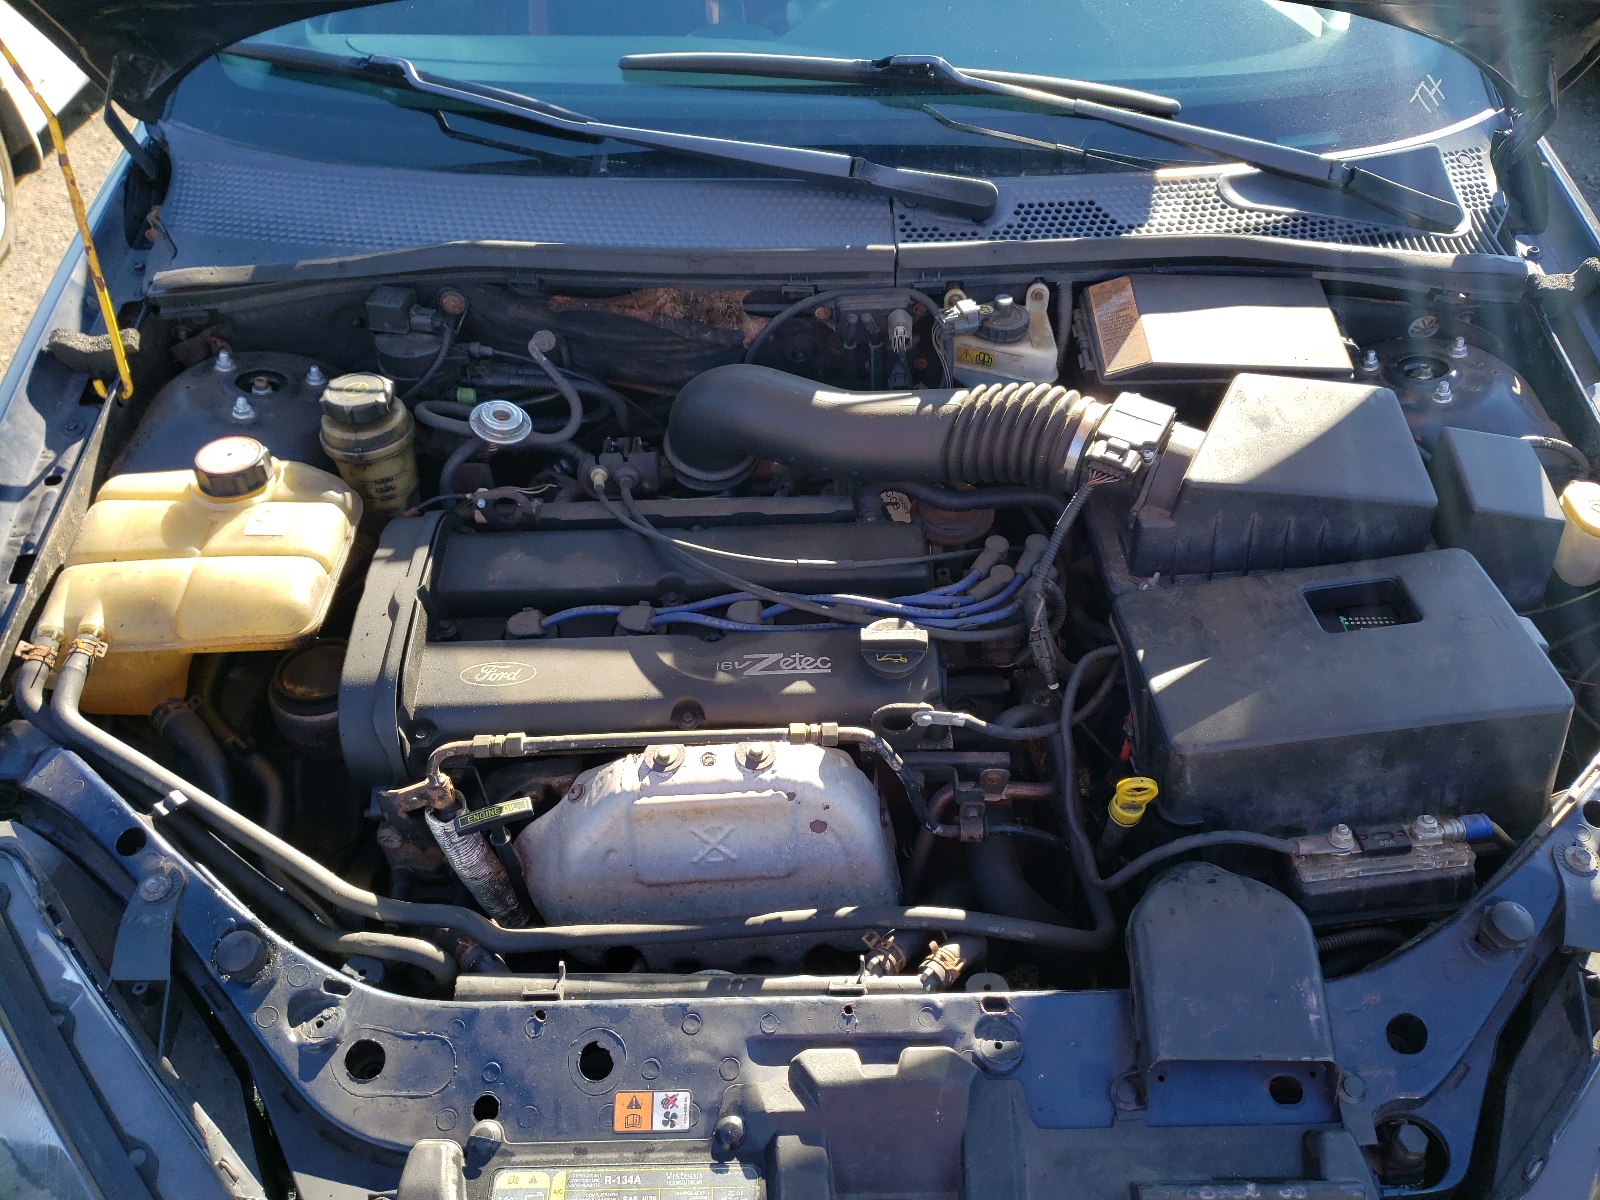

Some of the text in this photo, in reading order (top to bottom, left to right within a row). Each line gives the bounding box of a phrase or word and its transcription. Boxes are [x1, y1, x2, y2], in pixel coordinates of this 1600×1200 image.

[474, 664, 523, 682] Ford
[743, 652, 832, 676] Zetec
[467, 803, 518, 824] ENGINE OIL
[604, 1175, 641, 1185] R-134A
[665, 1171, 703, 1180] Visteon
